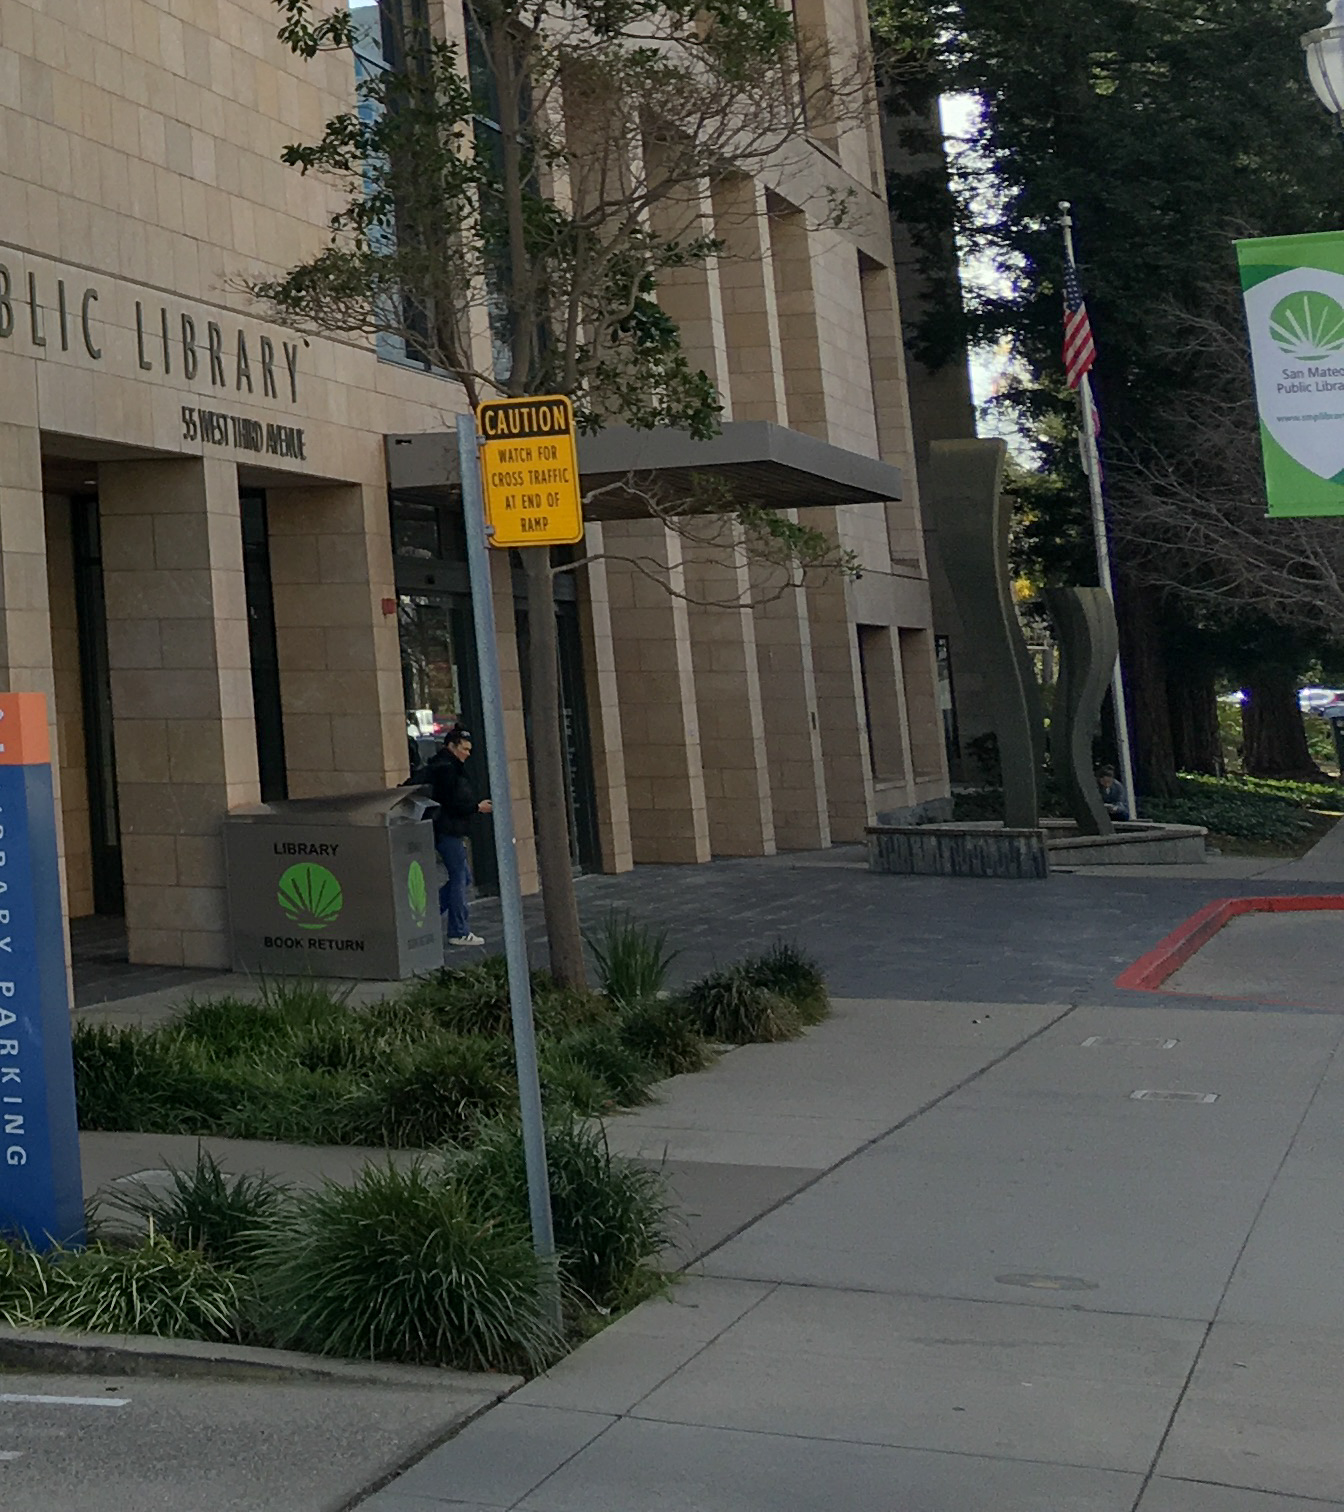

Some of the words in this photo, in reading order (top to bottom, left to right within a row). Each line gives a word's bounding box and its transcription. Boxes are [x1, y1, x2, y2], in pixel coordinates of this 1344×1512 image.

[134, 300, 302, 404] LIBRARY
[1281, 368, 1305, 380] San
[1276, 381, 1313, 394] Public
[484, 405, 567, 436] CAUTION
[181, 405, 198, 442] 55
[197, 408, 229, 447] WEST
[230, 415, 264, 453] THIRD
[265, 422, 308, 461] AVENUE
[498, 447, 533, 464] WATCH
[538, 444, 559, 461] FOR
[491, 471, 525, 489] CROSS
[527, 467, 570, 486] TRAFFIC
[505, 495, 517, 510] AT
[522, 494, 542, 509] END
[547, 492, 561, 508] OF
[520, 516, 549, 533] RAMP
[273, 842, 339, 857] LIBRARY
[264, 935, 305, 949] BOOK
[307, 937, 365, 952] RETURN
